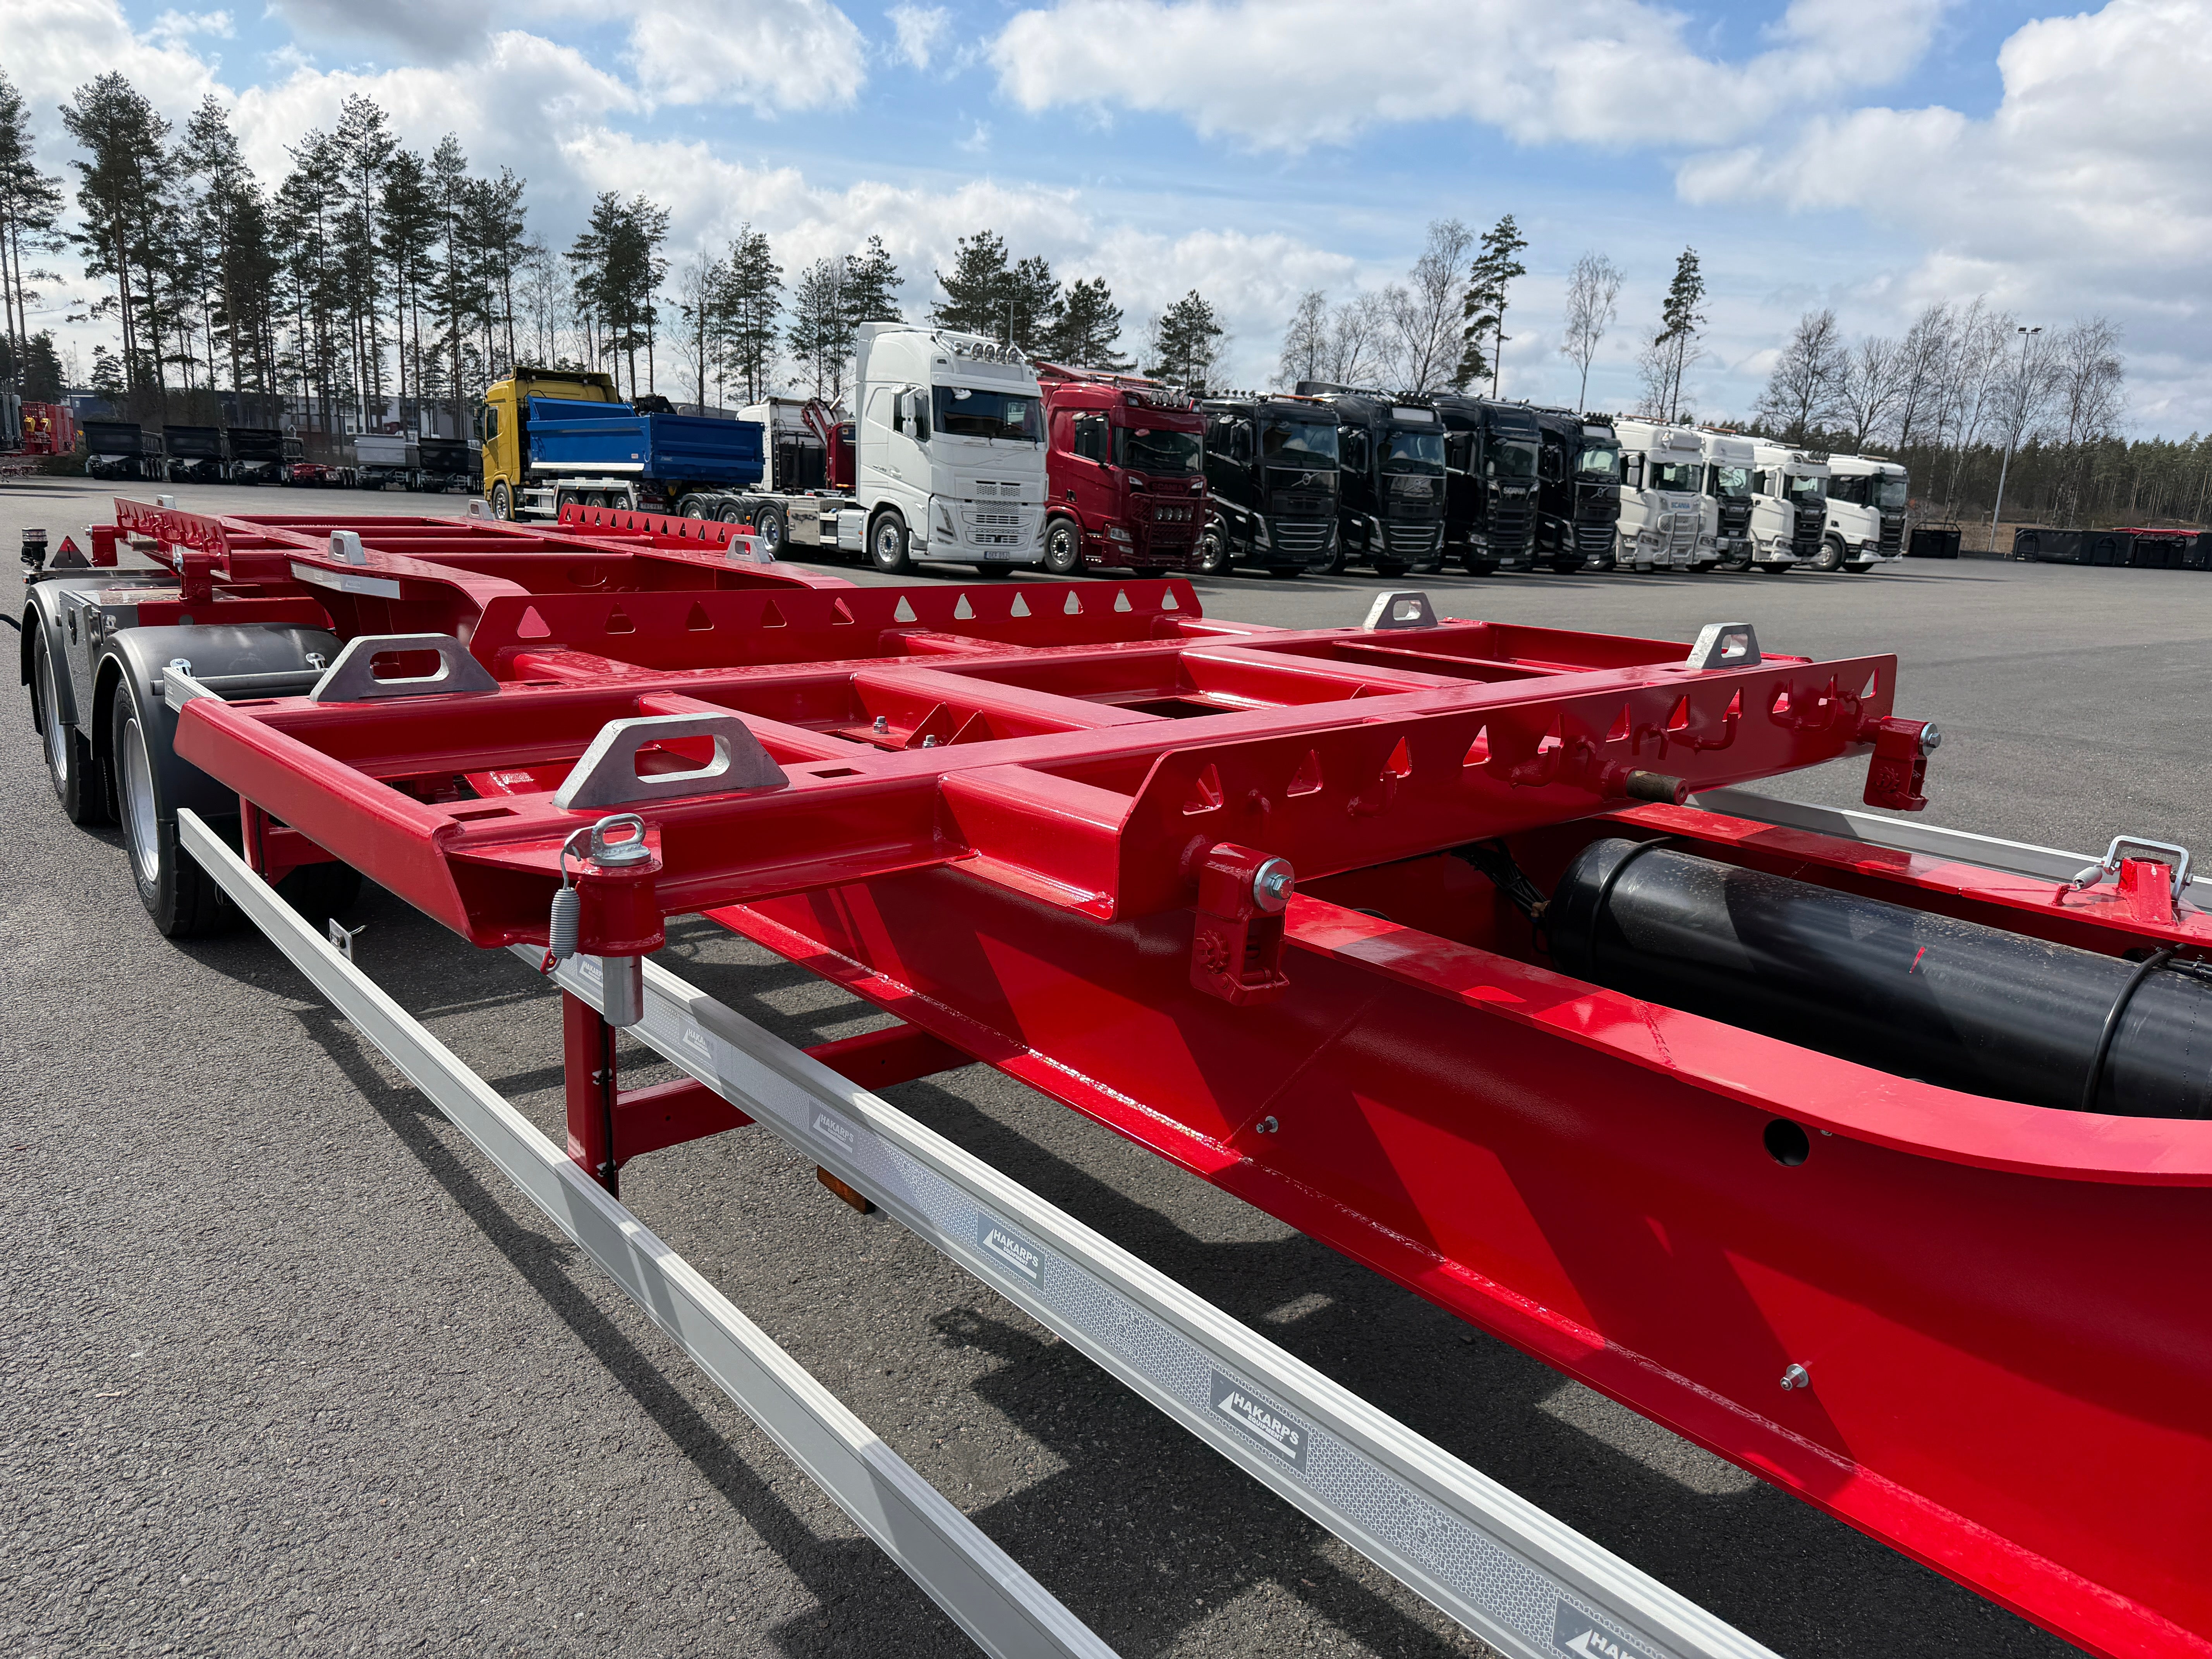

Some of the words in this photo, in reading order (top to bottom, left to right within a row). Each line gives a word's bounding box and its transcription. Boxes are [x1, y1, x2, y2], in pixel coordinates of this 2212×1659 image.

[1152, 483, 1184, 492] SCANIA
[821, 1114, 854, 1143] HAKARPS
[993, 1229, 1039, 1267] HAKARPS
[1003, 1246, 1028, 1266] EQUIPMENT
[1234, 1393, 1299, 1445] HAKARPS
[1248, 1414, 1284, 1441] EQUIPMENT
